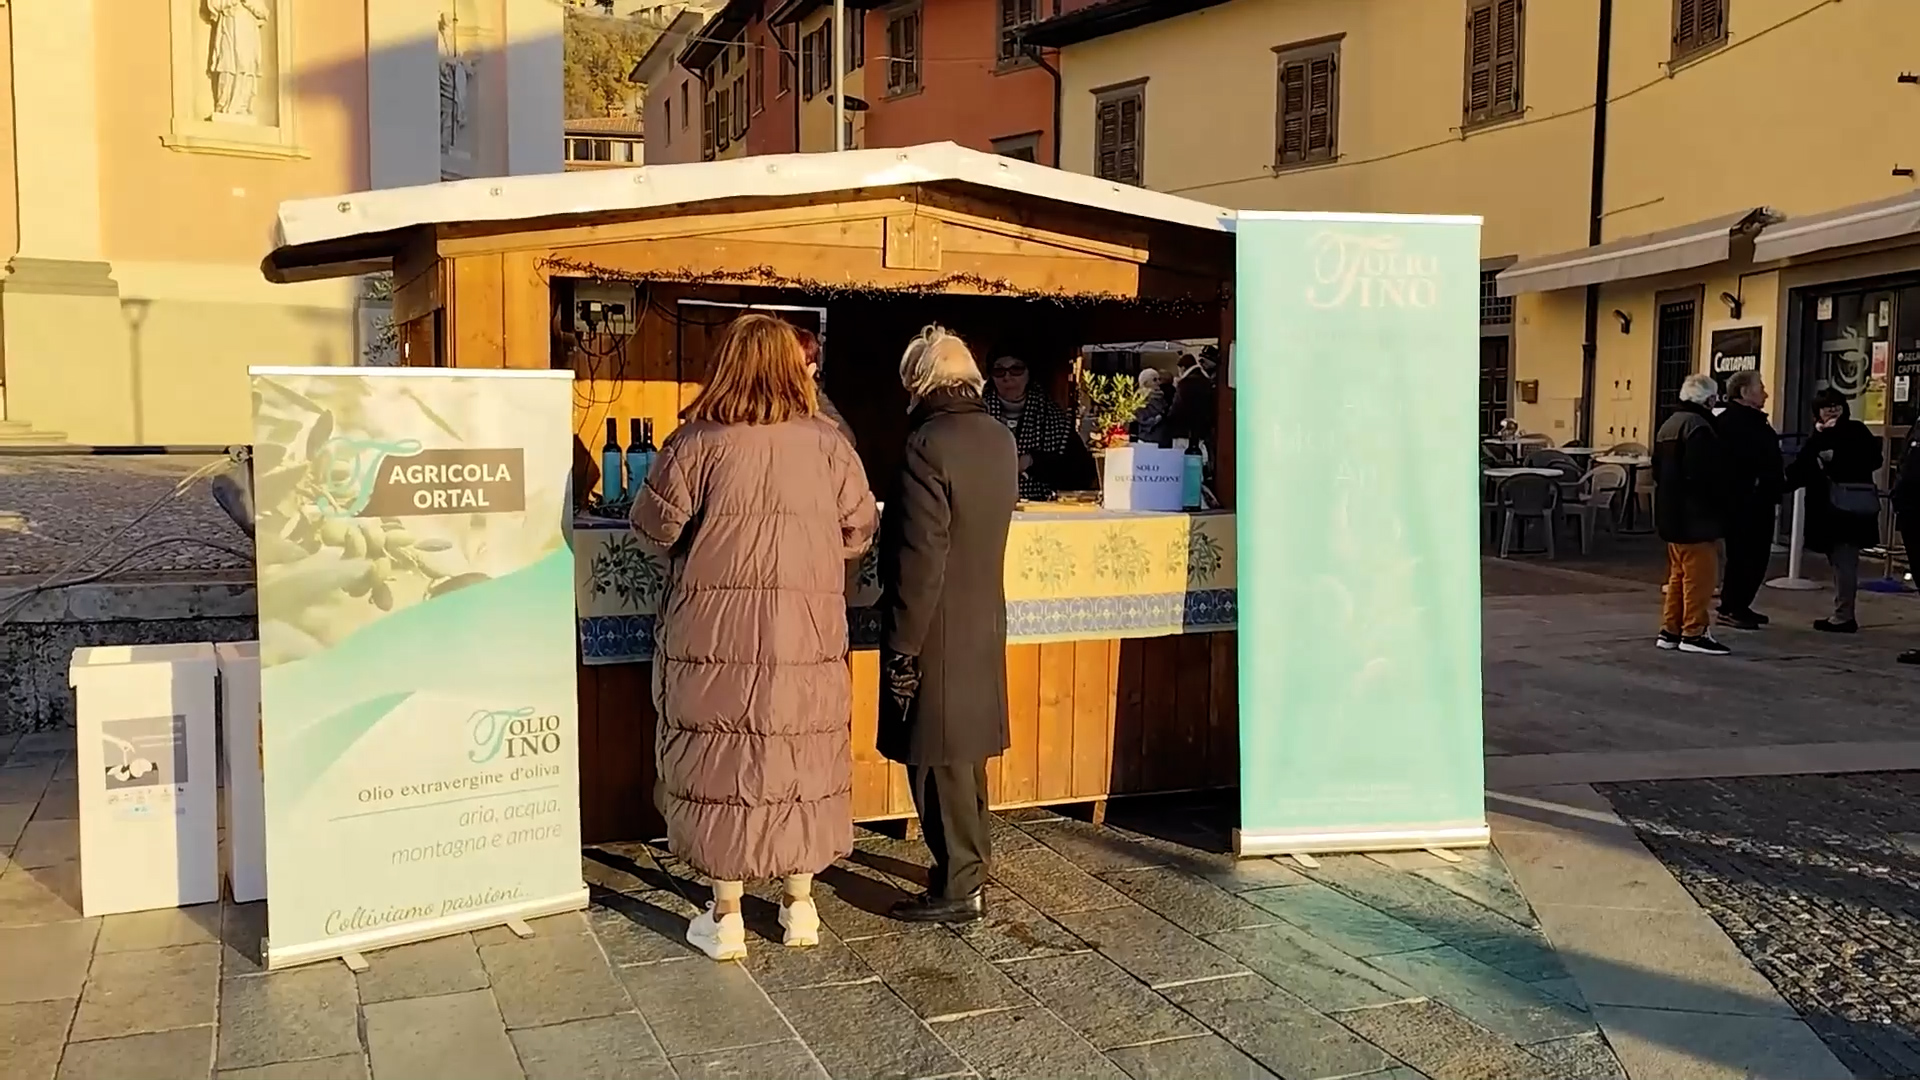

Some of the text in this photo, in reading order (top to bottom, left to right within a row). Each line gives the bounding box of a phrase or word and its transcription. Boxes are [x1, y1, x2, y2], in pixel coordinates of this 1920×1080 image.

[388, 463, 512, 485] AGRICOLA
[1136, 464, 1159, 472] SOLO
[413, 488, 490, 509] ORTAL
[508, 714, 560, 736] OLIO
[358, 763, 560, 802] Olio extravergine d'oliva
[391, 823, 562, 865] montagna e amore
[324, 905, 434, 936] Coltiviamo
